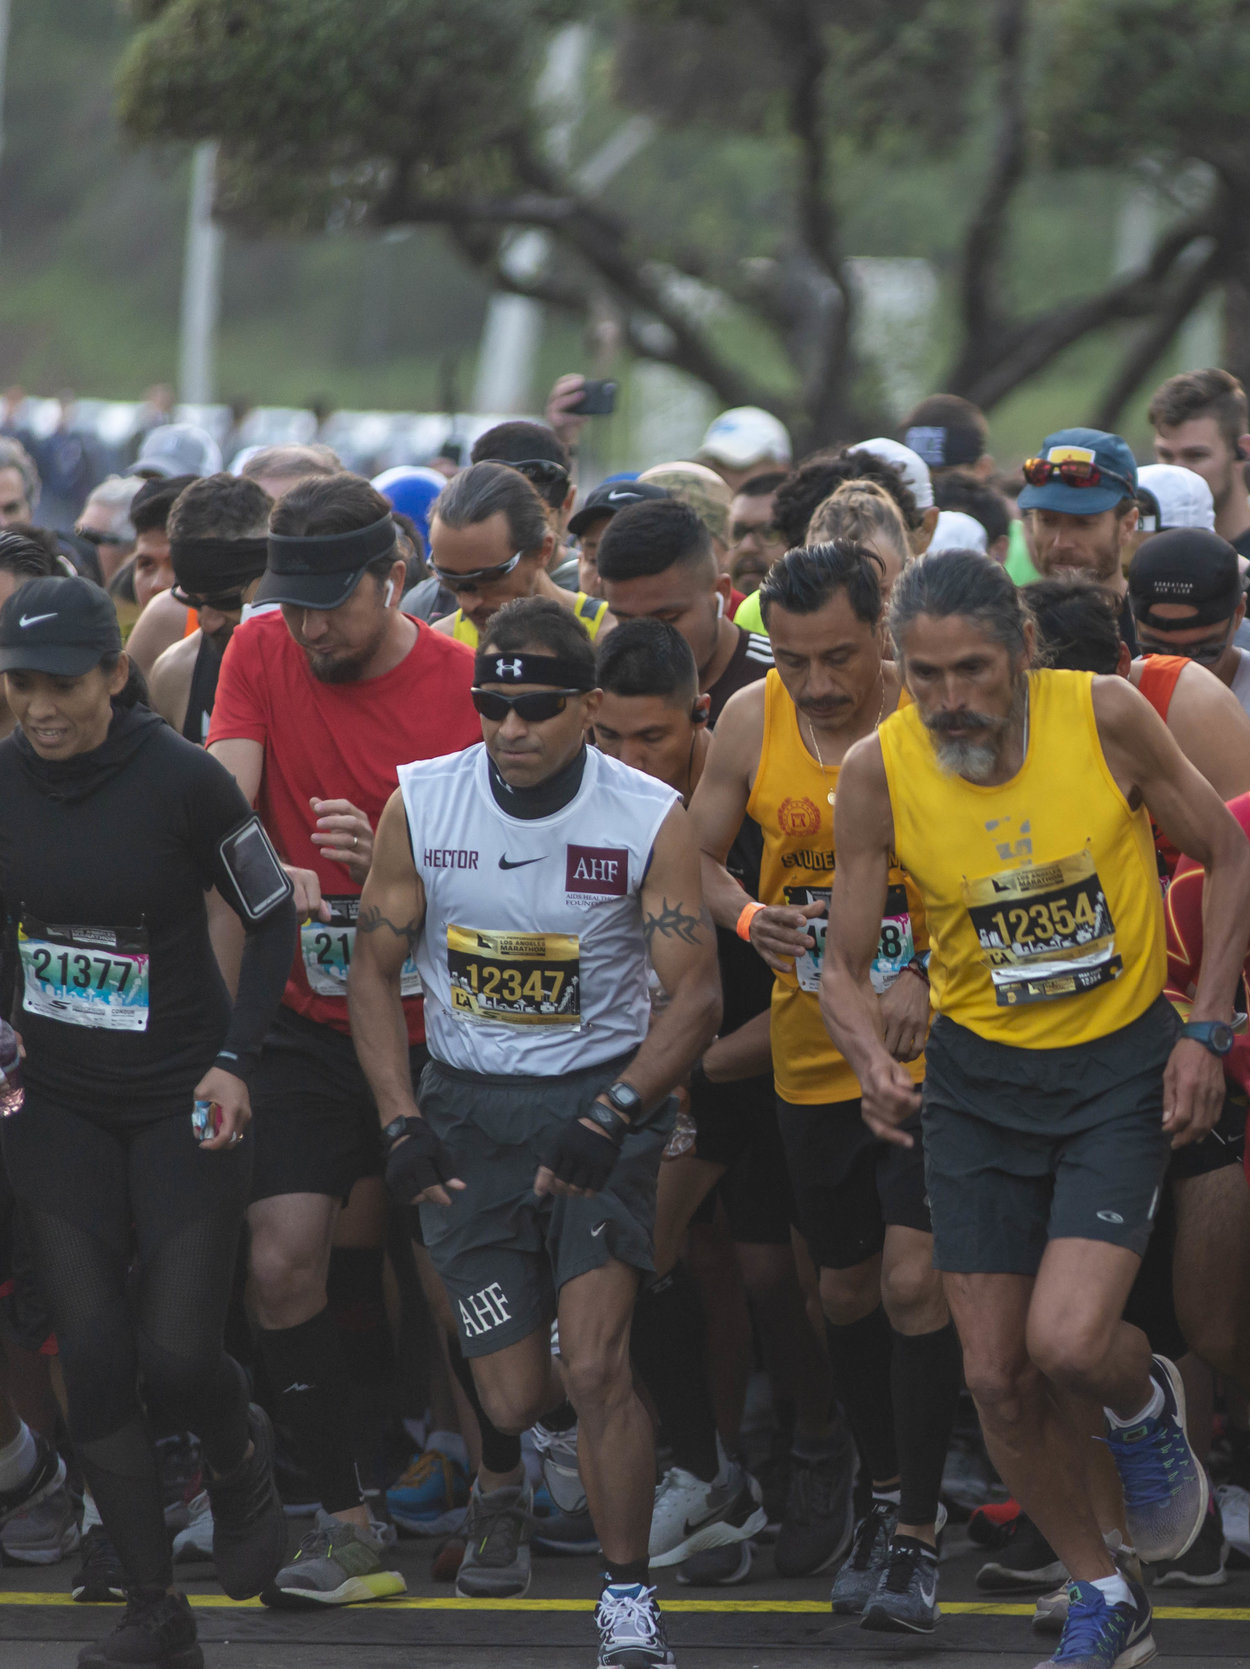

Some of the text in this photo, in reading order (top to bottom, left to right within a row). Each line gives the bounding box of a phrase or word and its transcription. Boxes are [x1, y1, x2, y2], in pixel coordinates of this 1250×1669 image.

[424, 848, 479, 870] HECTOR
[572, 856, 619, 883] AHF
[781, 850, 836, 871] STUDE
[992, 892, 1097, 946] 12354
[32, 948, 132, 992] 21377
[466, 963, 565, 1003] 12347
[455, 992, 473, 1011] LA
[458, 1282, 512, 1338] AHF
